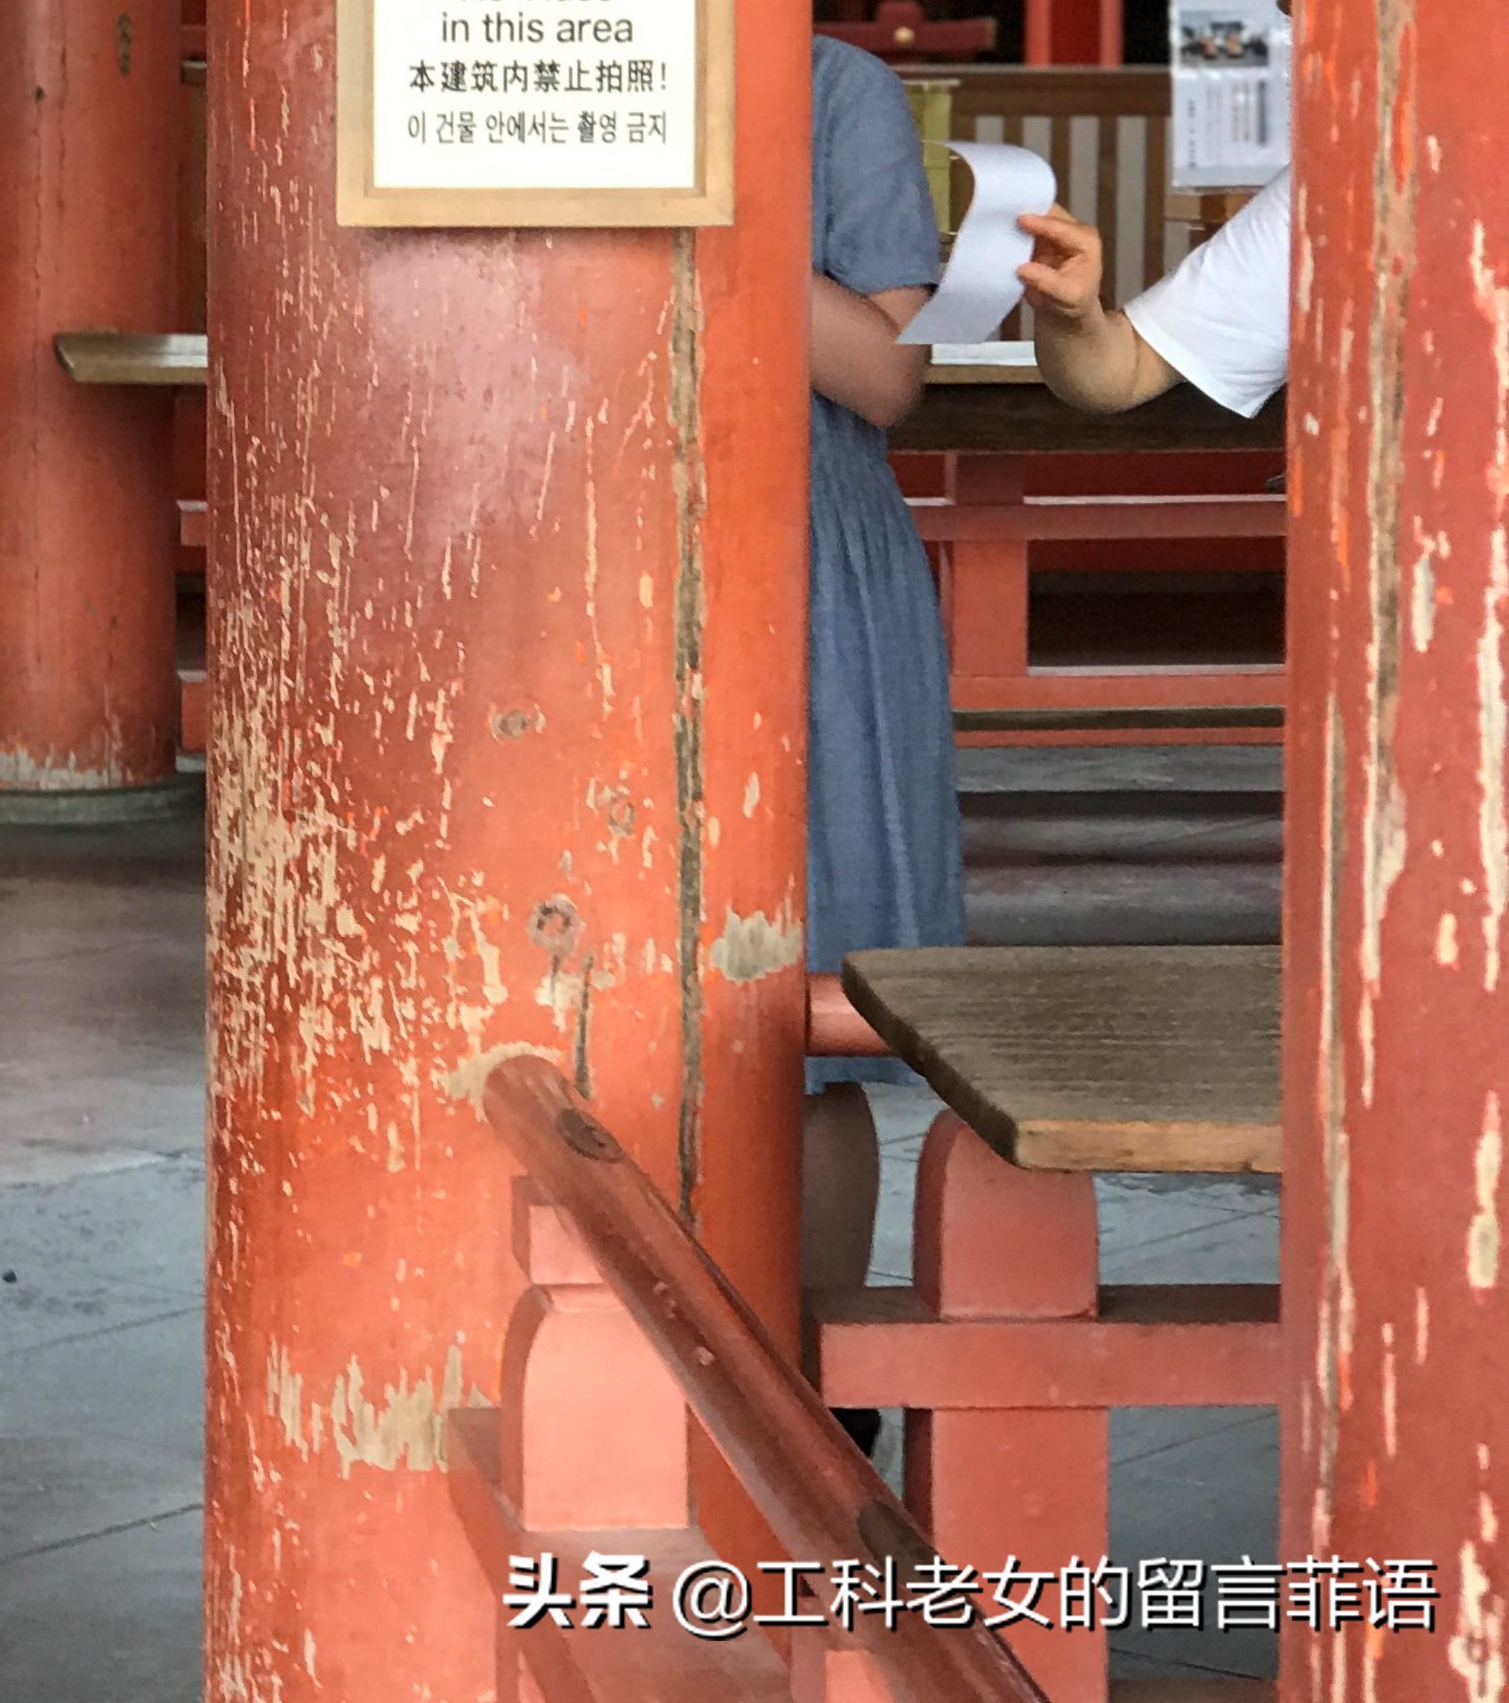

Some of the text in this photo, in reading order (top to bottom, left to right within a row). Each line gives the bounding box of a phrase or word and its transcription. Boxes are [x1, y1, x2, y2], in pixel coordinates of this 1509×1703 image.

[441, 11, 633, 43] in this area
[409, 59, 667, 93] 本建筑内禁止拍照!
[408, 111, 666, 144] 이 건물 안에서는 촬영 금지
